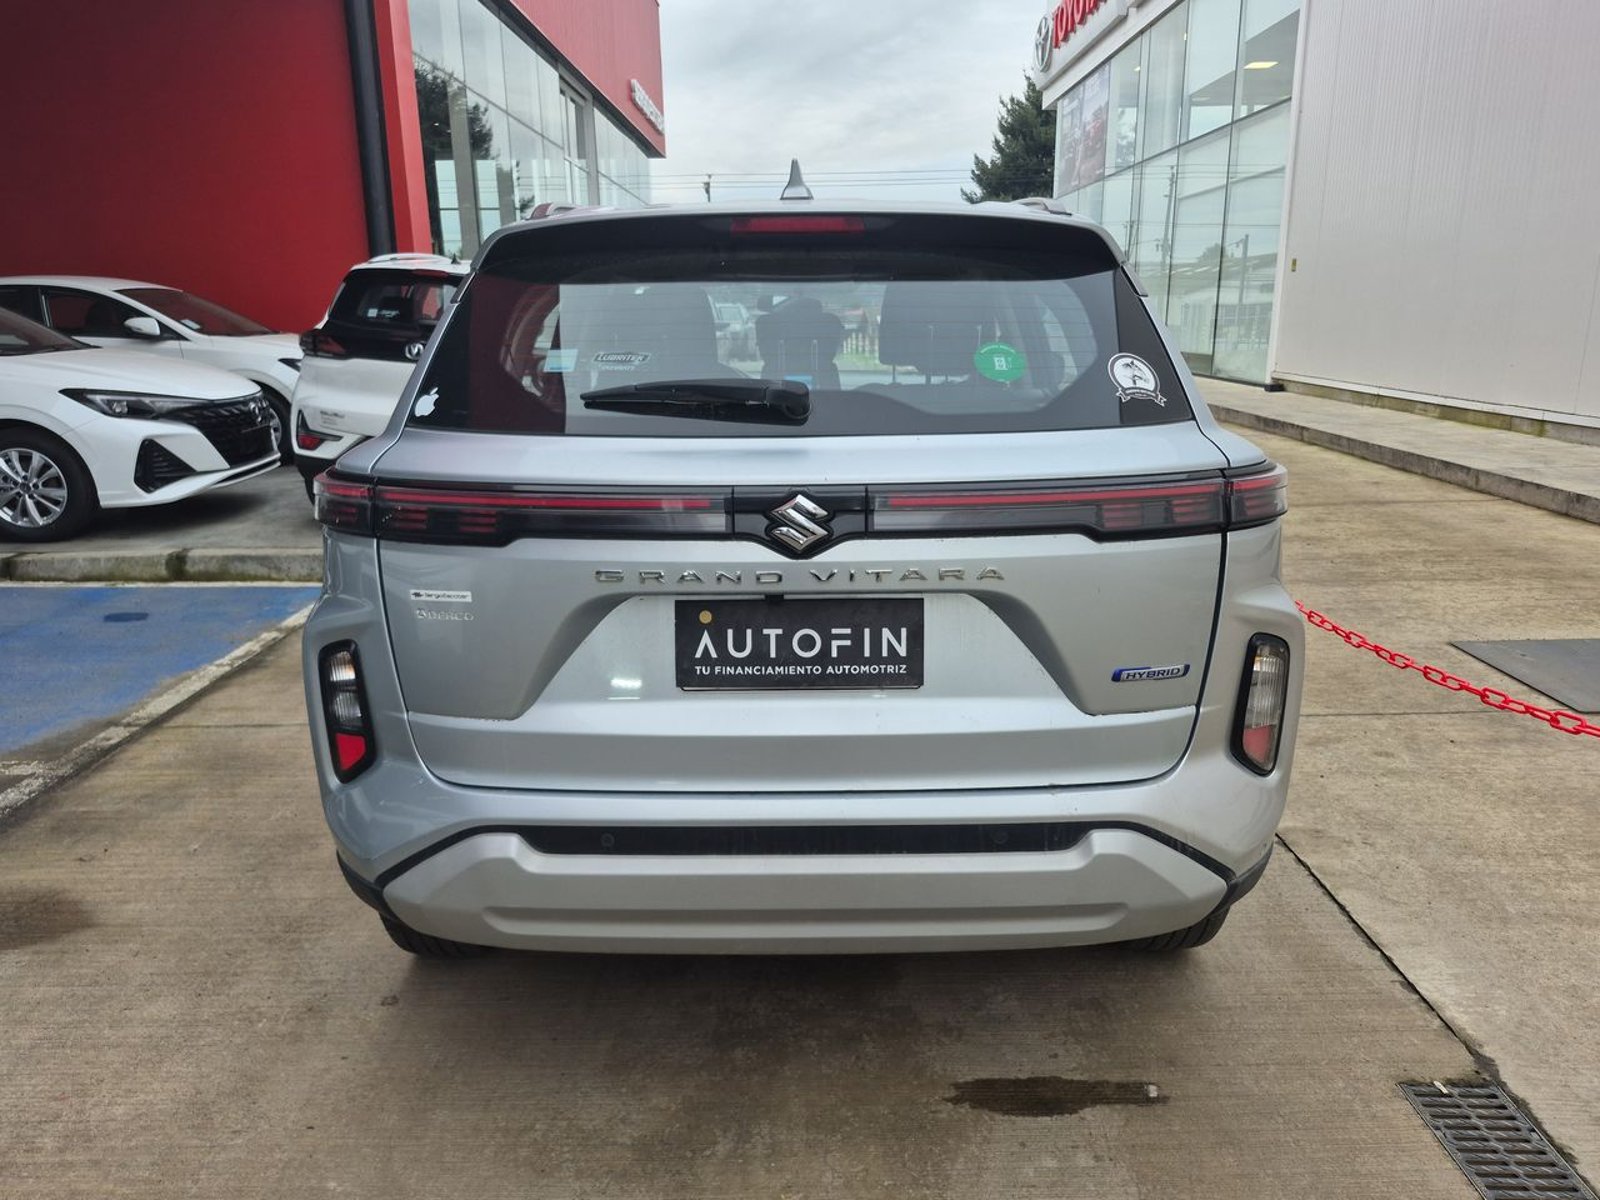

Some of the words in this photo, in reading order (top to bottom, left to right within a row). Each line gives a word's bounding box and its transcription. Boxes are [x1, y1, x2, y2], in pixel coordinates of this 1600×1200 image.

[1051, 0, 1105, 49] TOYO
[594, 569, 783, 585] GRAND
[809, 567, 1005, 583] VITARA
[694, 627, 908, 659] AUTOFIN
[694, 665, 711, 675] TU
[714, 665, 822, 675] FINANCIAMIENTO
[825, 664, 908, 675] AUTOMOTRIZ
[1125, 667, 1181, 680] HYBRID
